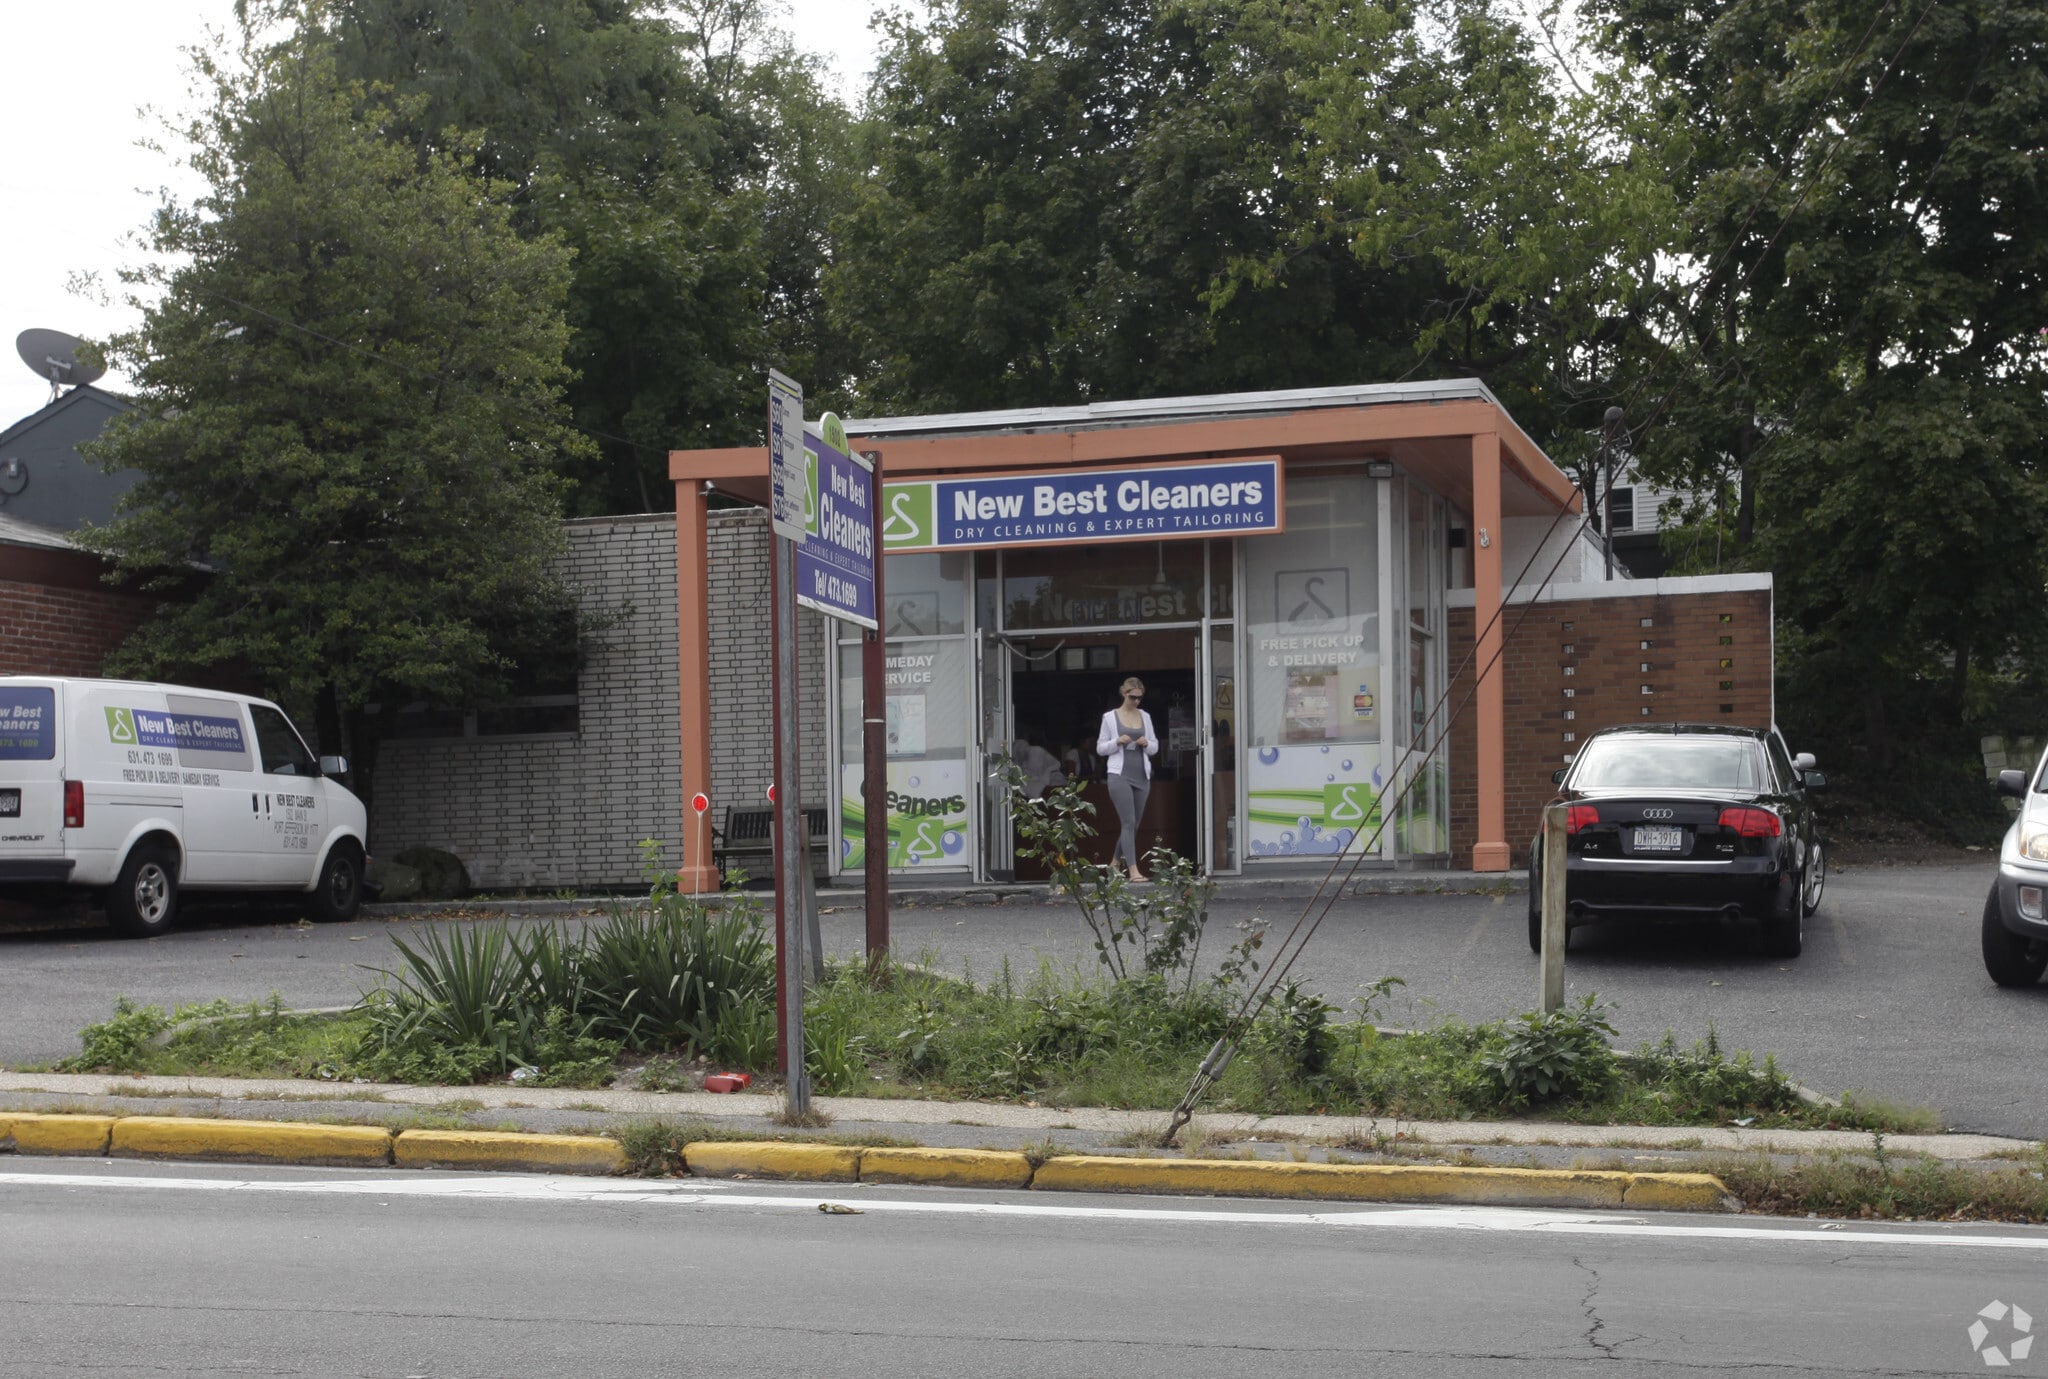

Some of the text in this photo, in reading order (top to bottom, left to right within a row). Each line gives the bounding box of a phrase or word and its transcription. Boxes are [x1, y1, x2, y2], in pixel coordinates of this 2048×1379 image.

[831, 464, 865, 509] New Best
[954, 480, 1263, 521] New Best Cleaners
[820, 492, 872, 560] Cleaners
[955, 512, 1264, 539] DRY CLEANING & EXPERT TAILORING
[1260, 635, 1364, 650] FREE PICK UP
[885, 655, 935, 668] MEDAY
[1267, 652, 1357, 667] & DELIVERY
[13, 705, 42, 719] Best
[137, 714, 240, 740] New Best Cleaners
[122, 769, 135, 783] FREE
[136, 770, 148, 784] PICK
[159, 771, 181, 785] DELIVERY
[861, 783, 967, 818] eaners
